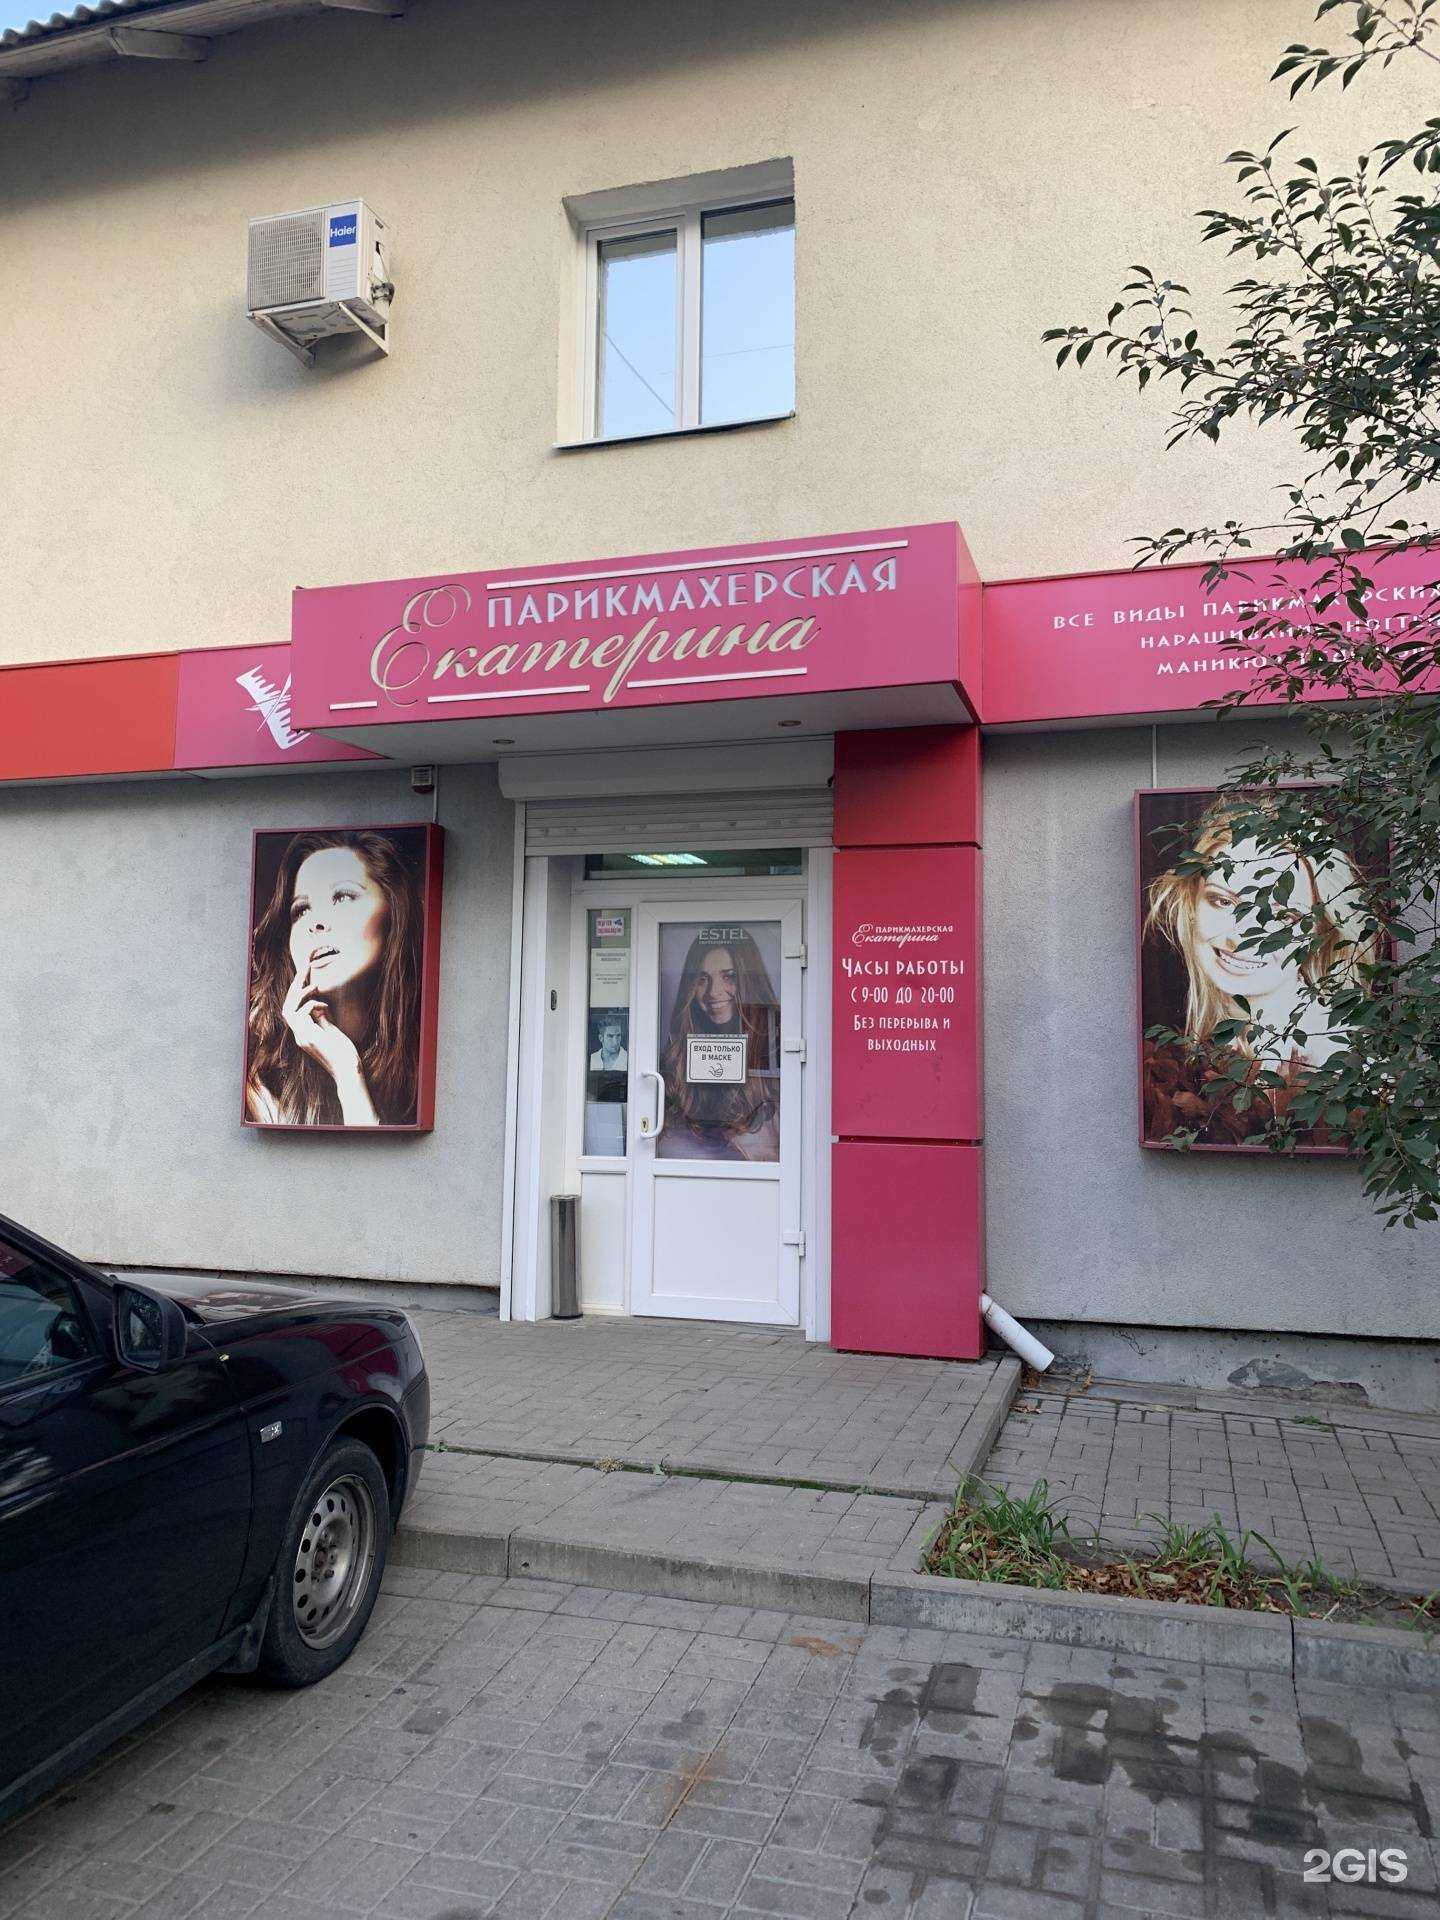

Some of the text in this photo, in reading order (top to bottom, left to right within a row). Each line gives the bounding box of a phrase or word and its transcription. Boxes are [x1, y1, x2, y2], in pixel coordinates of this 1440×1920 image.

[330, 225, 357, 238] Haier
[487, 555, 898, 628] ПАРИКМАХЕРСКАЯ
[1053, 612, 1094, 630] ВСЕ
[1113, 604, 1186, 625] ВИДЫ
[369, 585, 822, 708] Екатерина
[1156, 654, 1284, 676] МАНИКЮ
[699, 927, 749, 940] ESTEL
[851, 923, 940, 949] Екатерина
[875, 925, 954, 933] ПАРИКМАХЕРСКАЯ
[896, 959, 965, 975] РАБОТЫ
[862, 986, 889, 1004] 9-00
[895, 986, 913, 1005] ДО
[921, 986, 955, 1003] 20-00
[879, 1016, 939, 1030] ПЕРЕРЫВА
[943, 1017, 951, 1029] И
[693, 1045, 741, 1053] ВХОД ТОЛЬКО
[867, 1037, 937, 1052] ВЫХОДНЫХ
